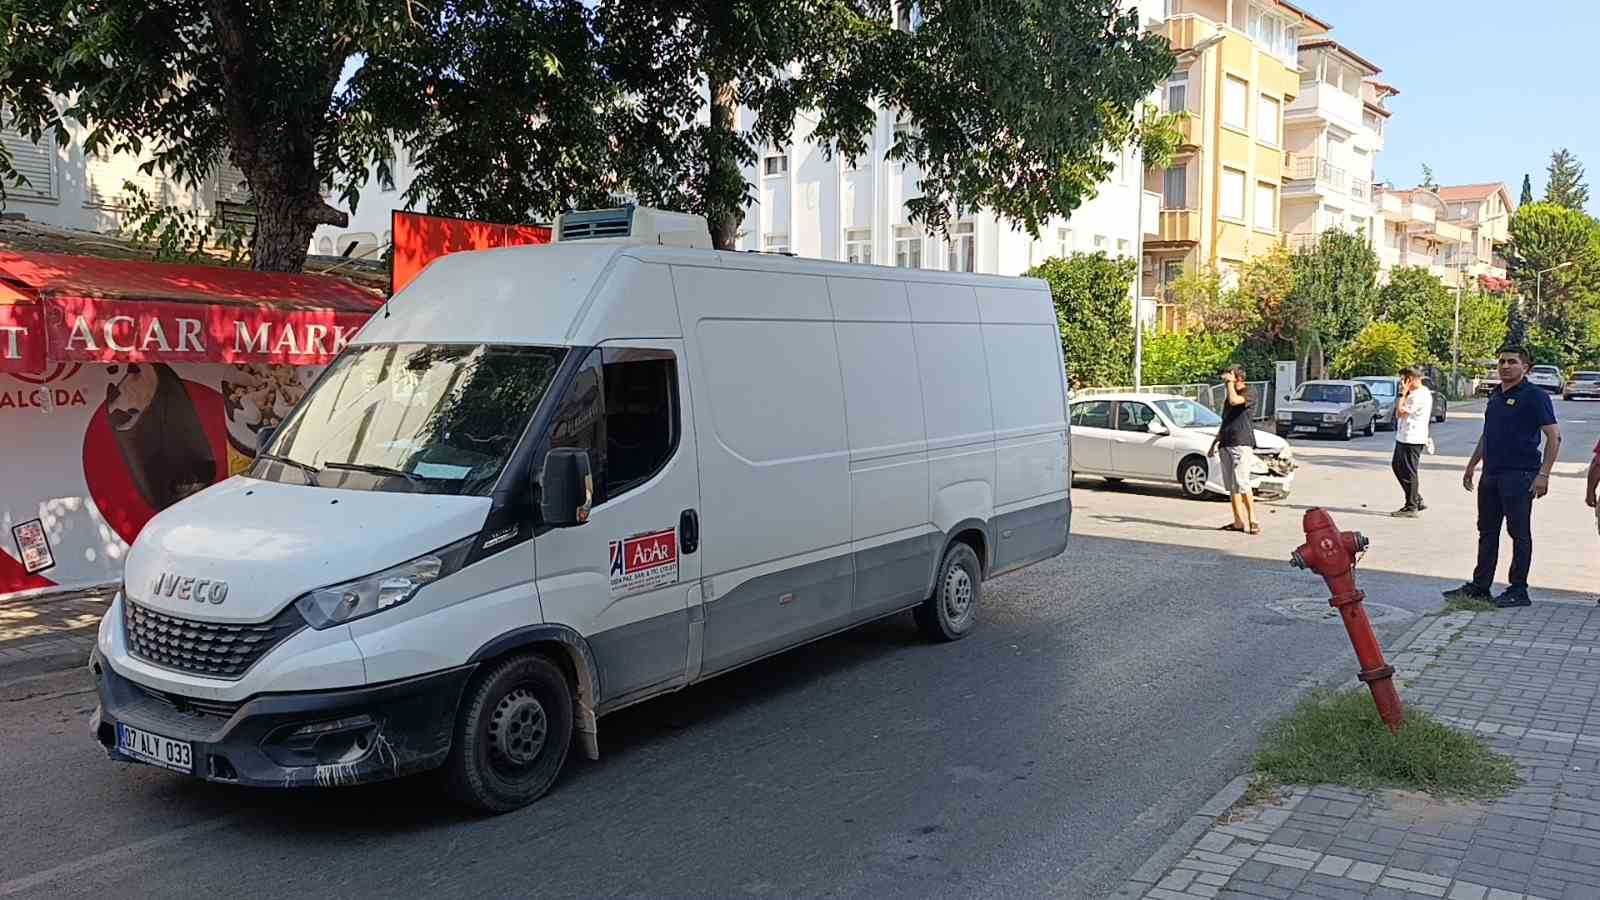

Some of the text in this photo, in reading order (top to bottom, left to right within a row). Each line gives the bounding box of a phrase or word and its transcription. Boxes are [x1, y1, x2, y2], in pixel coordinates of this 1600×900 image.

[65, 315, 206, 352] ACAR
[153, 573, 229, 605] IVECO
[125, 728, 137, 748] 07
[141, 734, 160, 757] ALY
[166, 742, 190, 765] 033
